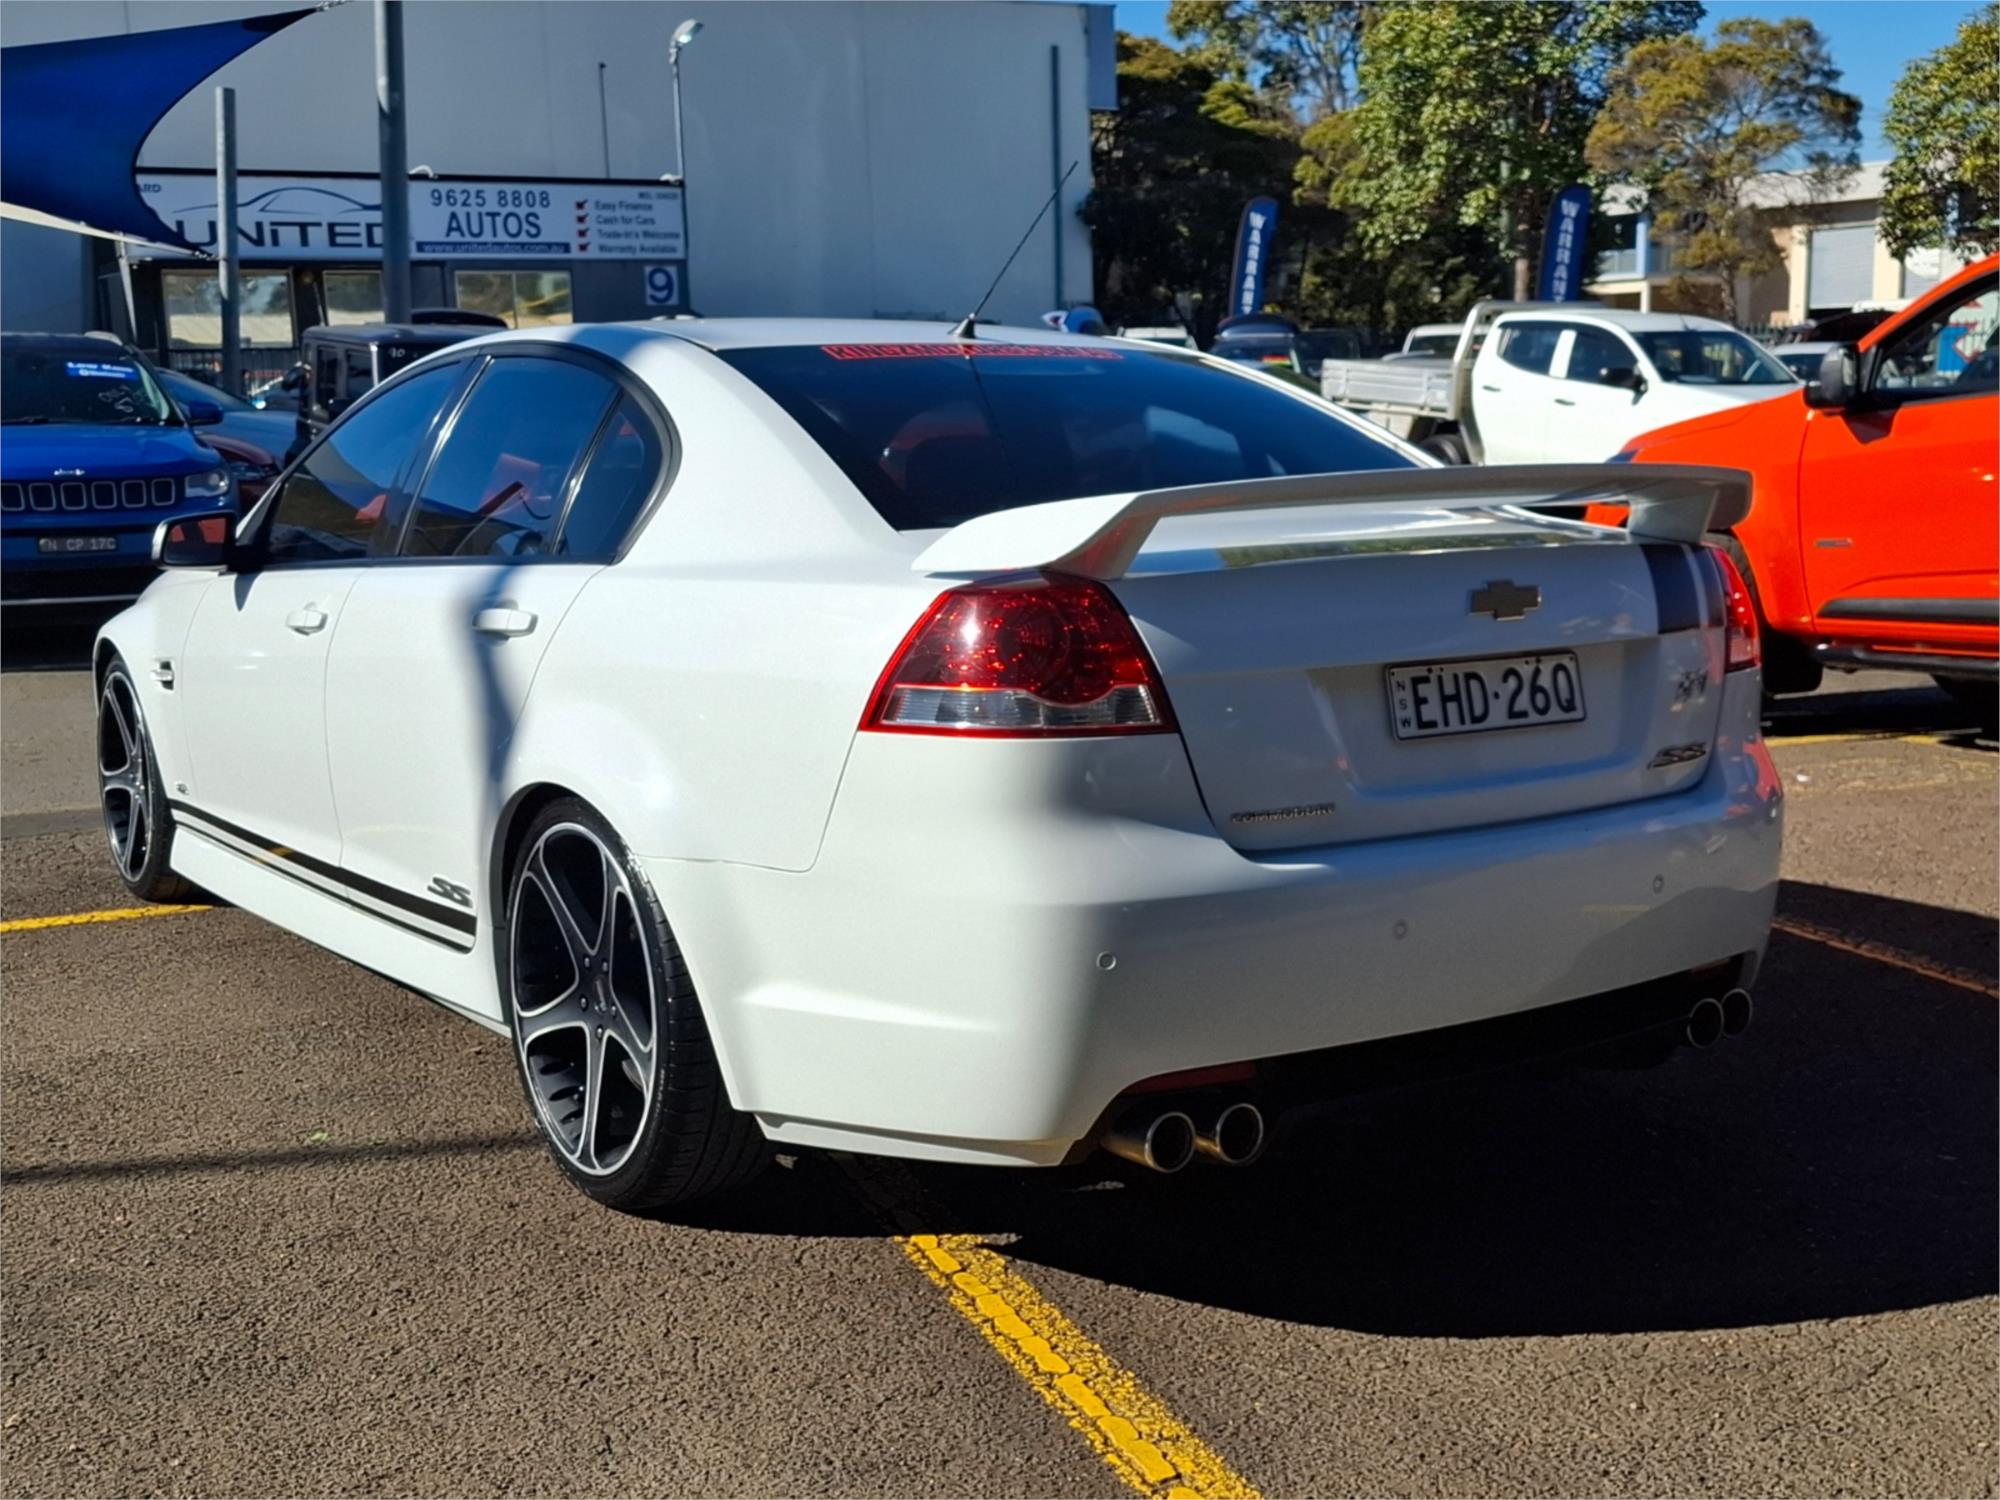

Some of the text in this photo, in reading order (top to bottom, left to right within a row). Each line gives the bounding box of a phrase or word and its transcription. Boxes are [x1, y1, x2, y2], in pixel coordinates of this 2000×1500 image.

[431, 189, 550, 208] 9625 8808
[445, 211, 541, 239] AUTOS
[648, 267, 674, 304] 9
